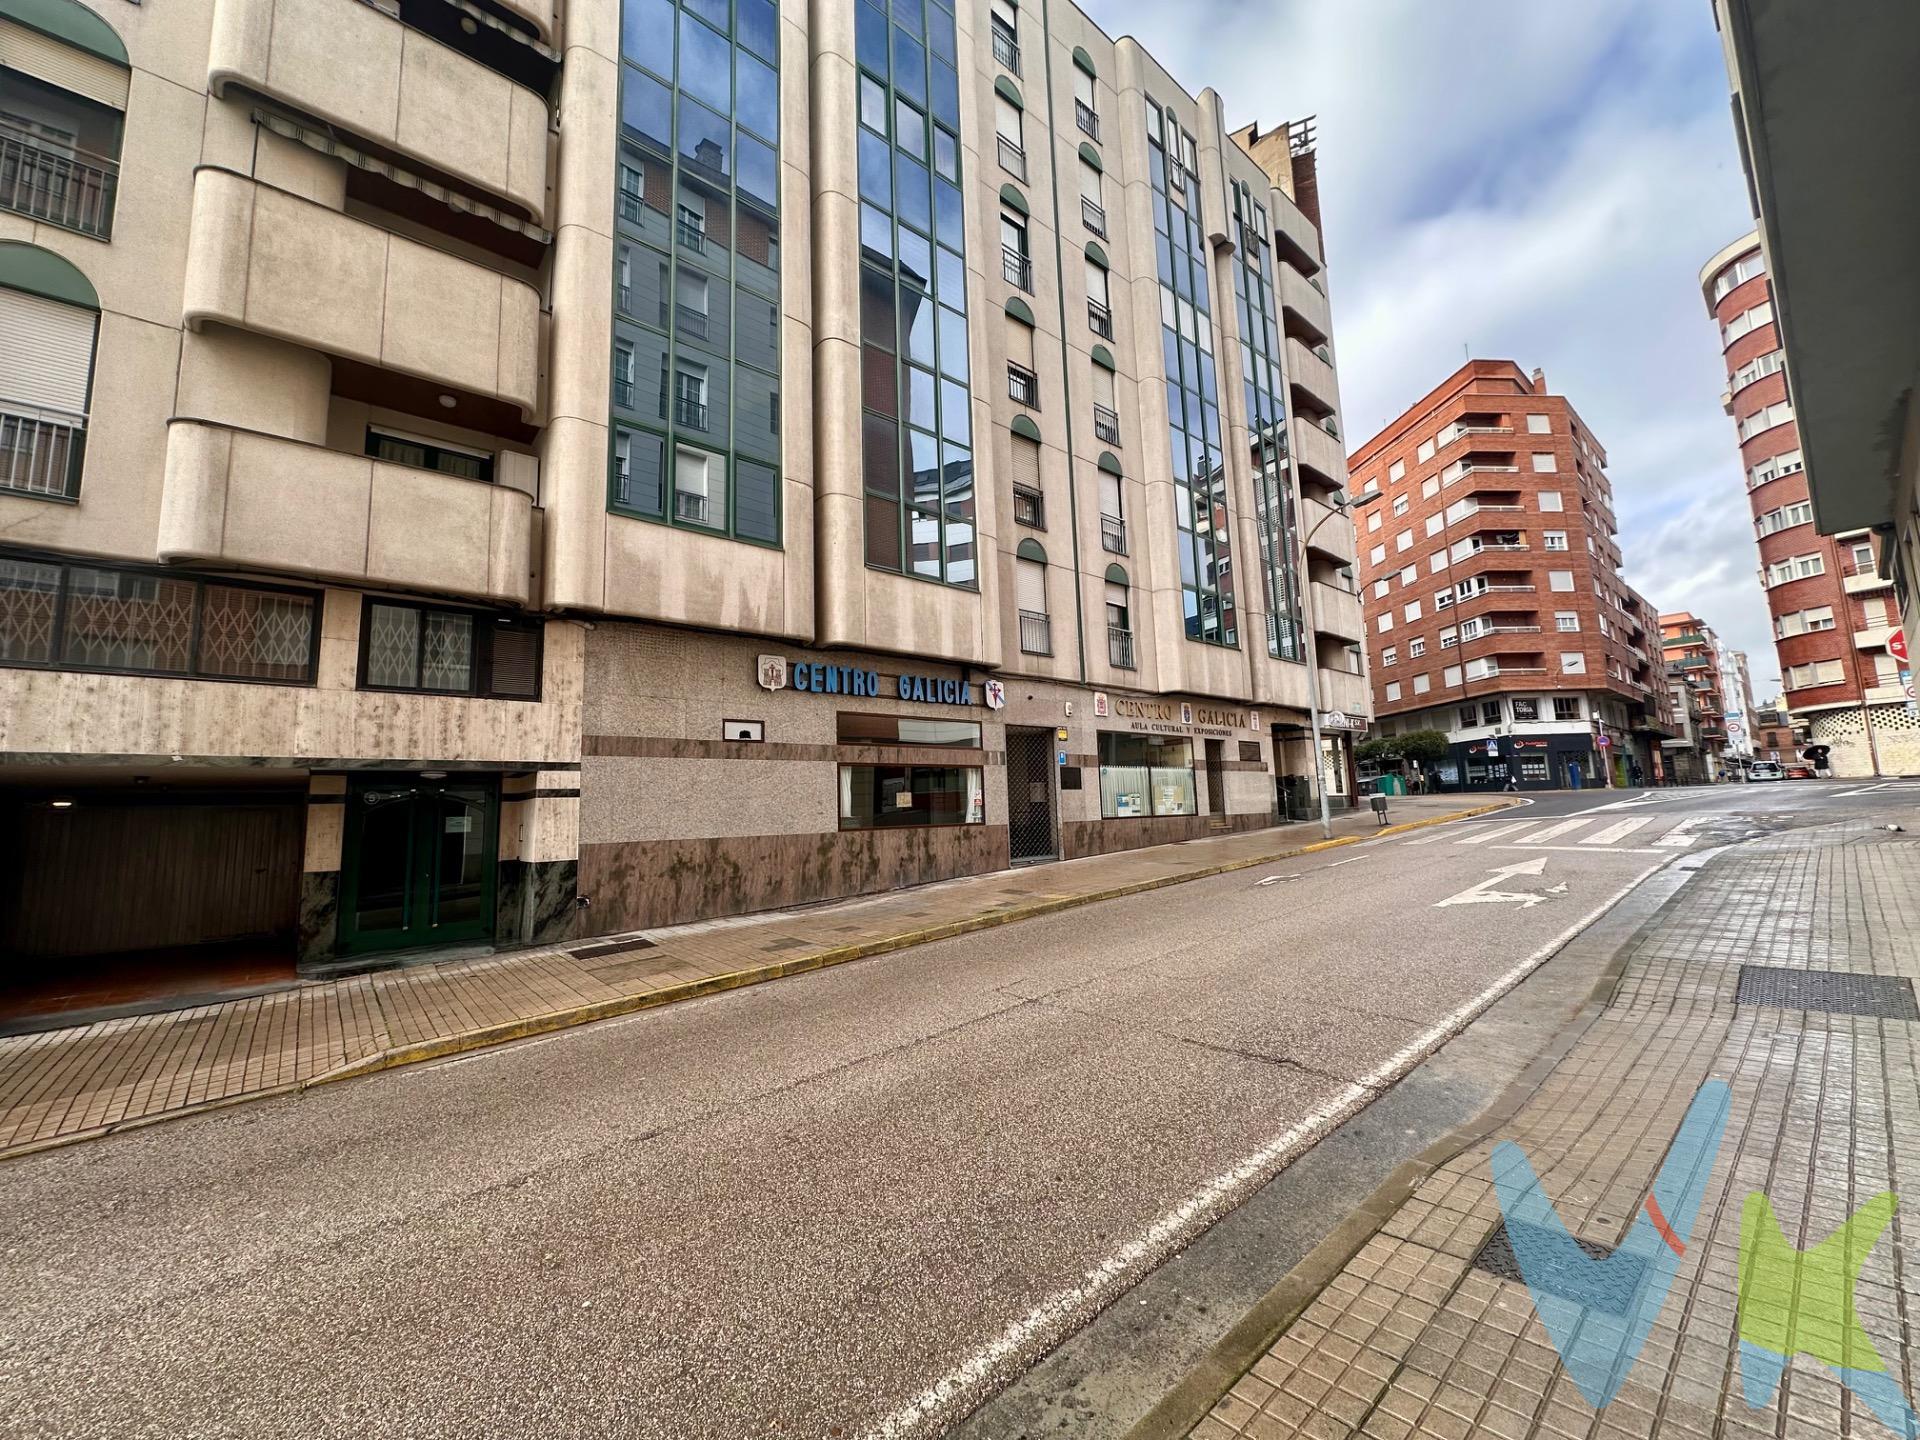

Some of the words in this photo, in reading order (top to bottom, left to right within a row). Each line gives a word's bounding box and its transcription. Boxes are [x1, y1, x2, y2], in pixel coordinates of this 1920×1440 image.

[794, 662, 880, 697] CENTRO
[899, 675, 972, 705] GALICIA
[1115, 699, 1171, 721] CENTRO
[1198, 709, 1246, 728] GALICIA
[1131, 721, 1148, 731] AULA
[1151, 723, 1184, 734] CULTURAL
[1193, 727, 1232, 737] EXPOSICIONES
